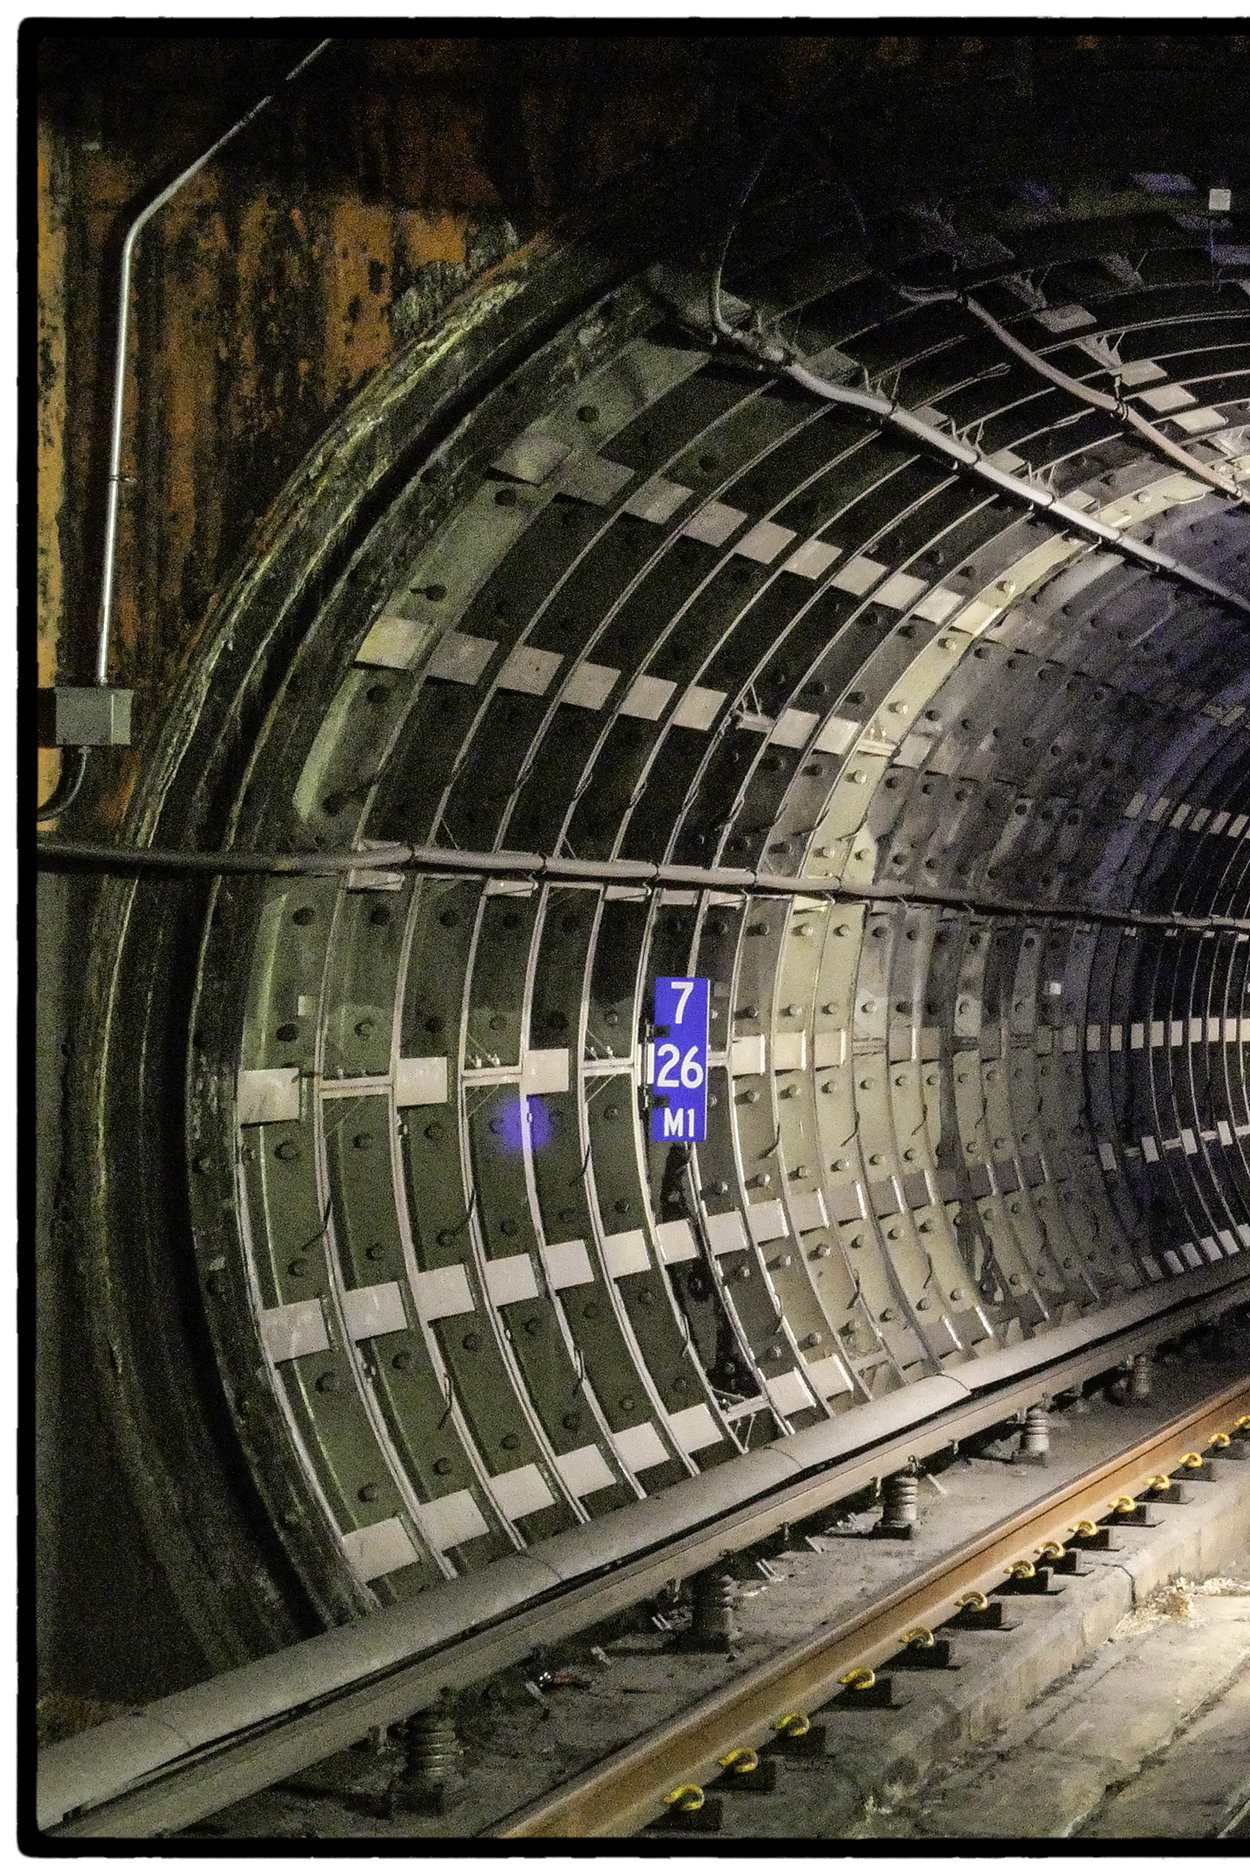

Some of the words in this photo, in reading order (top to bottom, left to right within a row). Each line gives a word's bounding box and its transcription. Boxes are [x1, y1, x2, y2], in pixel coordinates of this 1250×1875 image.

[671, 981, 694, 1024] 7
[657, 1043, 704, 1089] 26
[664, 1107, 695, 1138] M1
